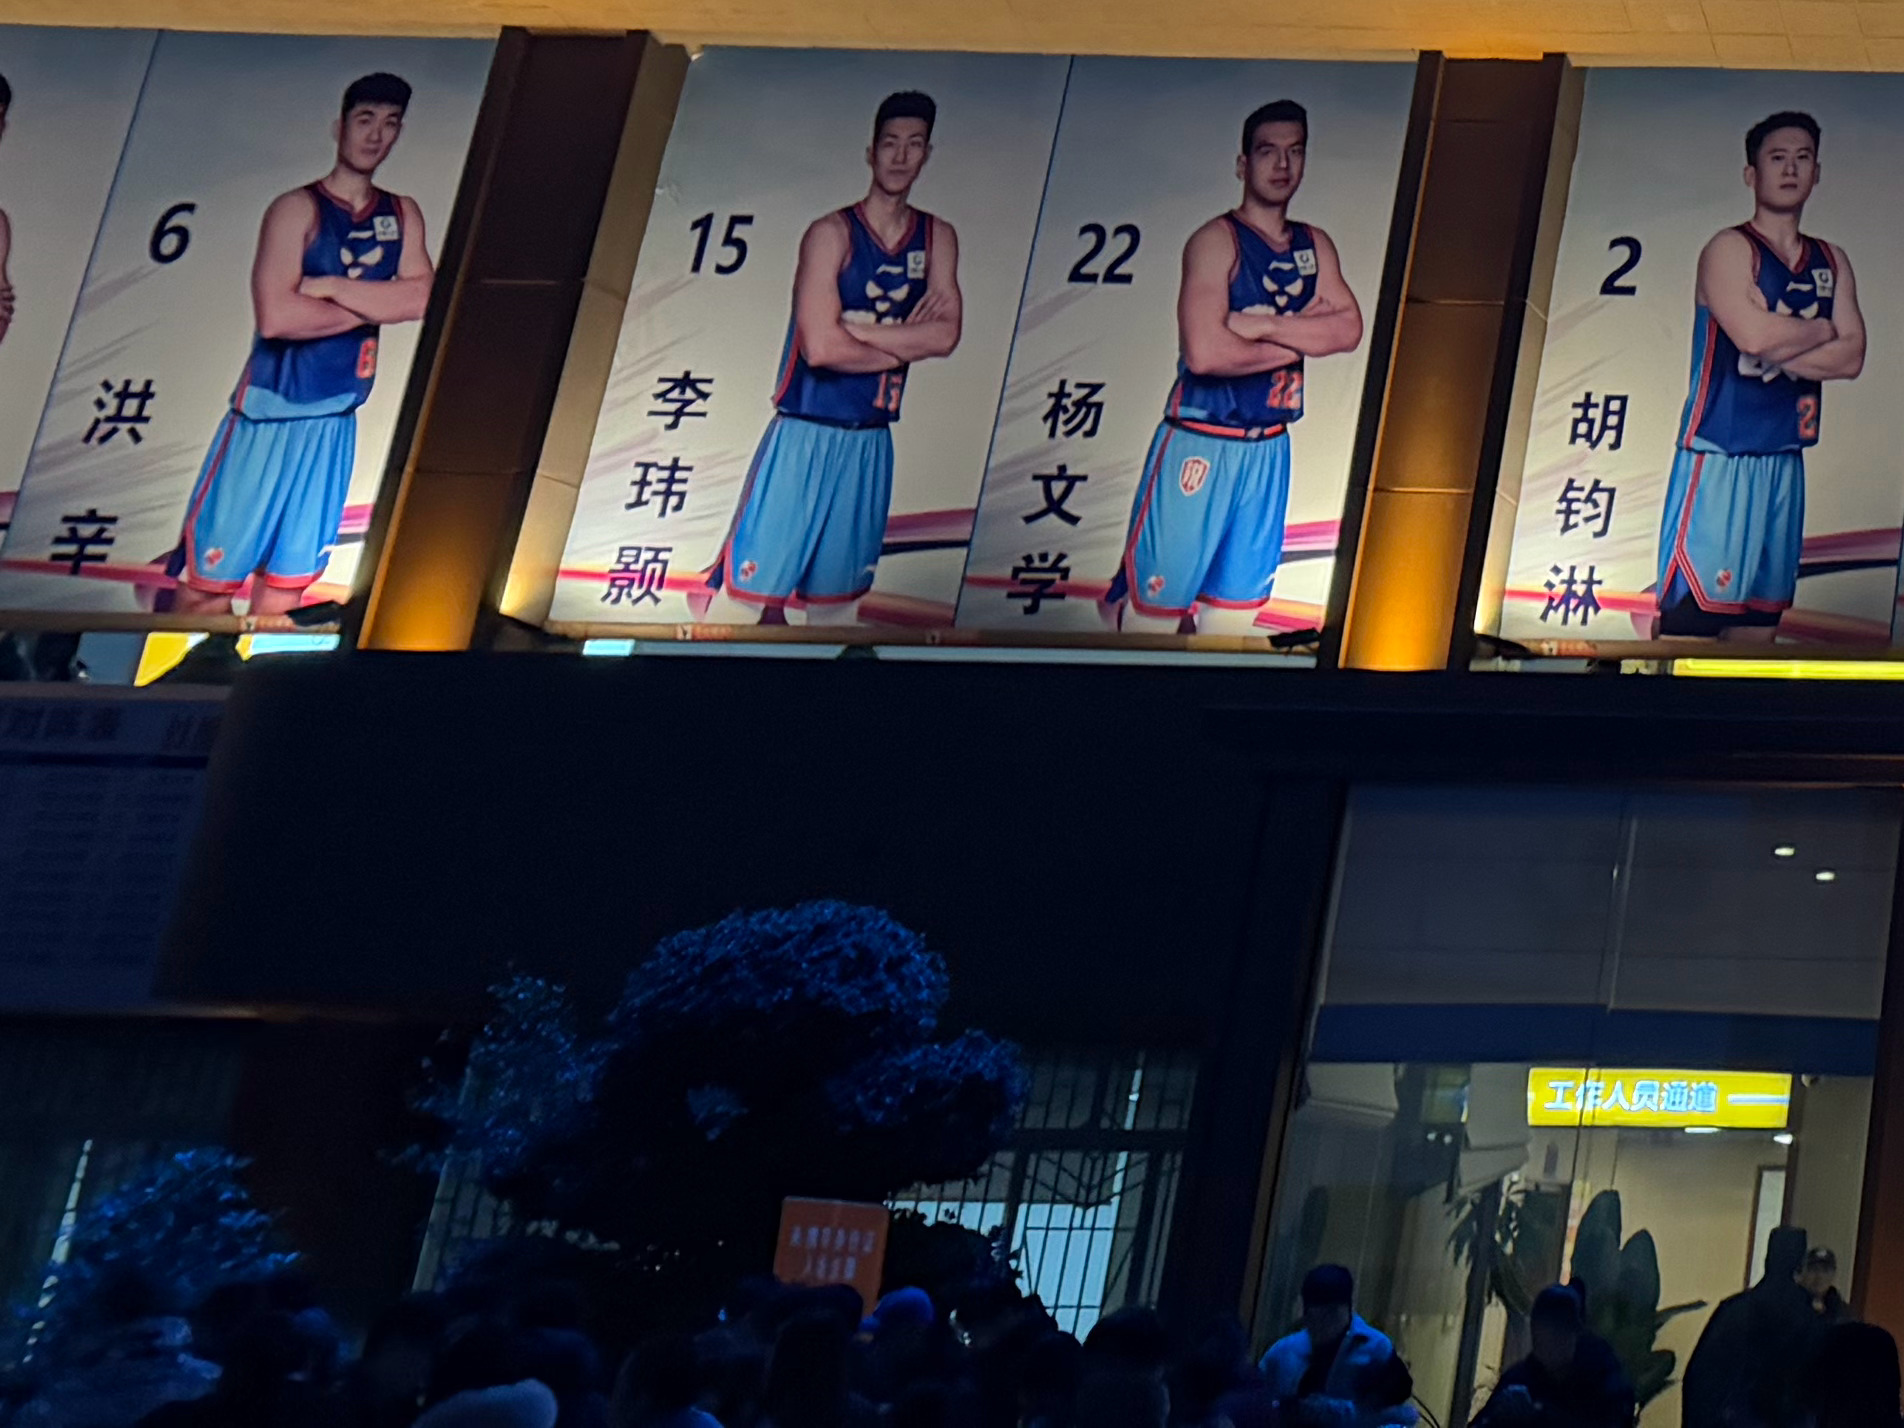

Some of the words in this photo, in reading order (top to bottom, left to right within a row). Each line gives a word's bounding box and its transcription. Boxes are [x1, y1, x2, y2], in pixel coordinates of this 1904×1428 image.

[149, 202, 197, 265] 6
[689, 213, 754, 275] 15
[1068, 223, 1142, 285] 22
[1599, 236, 1642, 296] 2
[356, 337, 376, 378] 6
[1267, 370, 1302, 409] 22
[1797, 396, 1817, 438] 2
[51, 379, 155, 575] 洪辛
[601, 371, 714, 606] 李玮颢
[1006, 379, 1106, 615] 杨文学
[1539, 392, 1629, 627] 胡钧淋
[1544, 1080, 1718, 1113] 工作人员通道
